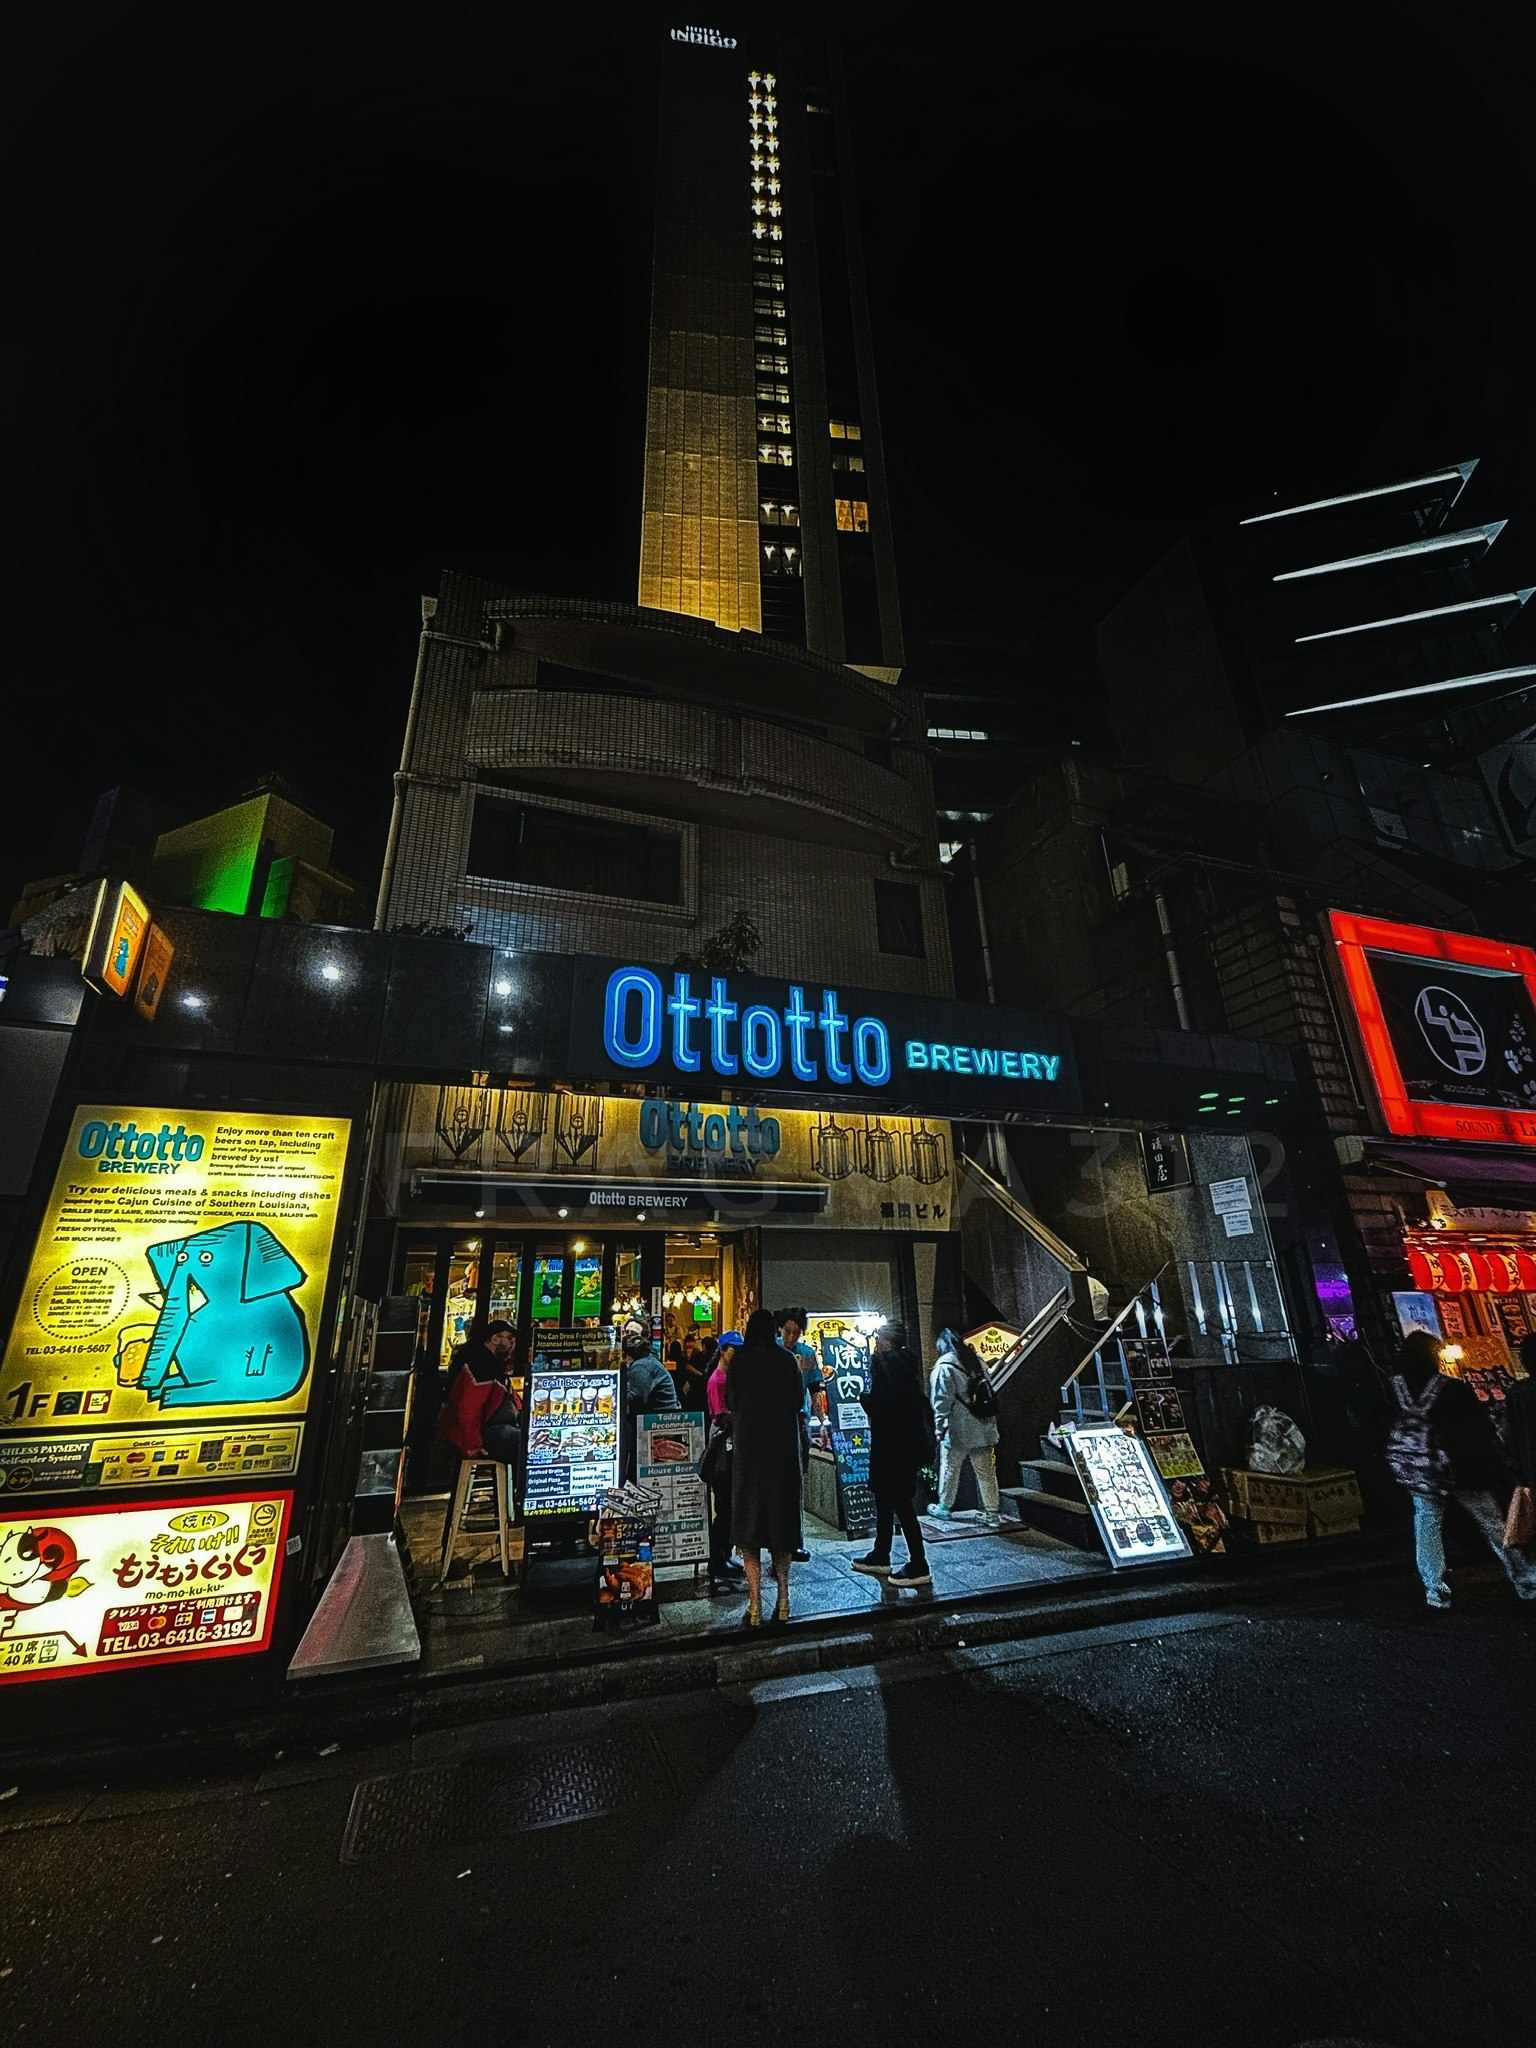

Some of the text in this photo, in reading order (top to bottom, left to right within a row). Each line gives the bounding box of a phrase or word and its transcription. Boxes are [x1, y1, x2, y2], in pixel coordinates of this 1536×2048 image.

[670, 28, 737, 49] INDIGO
[604, 966, 1060, 1087] Ottotto BREWERY
[640, 1098, 781, 1155] Ottotto
[1456, 1120, 1494, 1134] SOUND
[216, 1127, 243, 1137] Enjoy
[272, 1129, 293, 1137] than
[312, 1132, 335, 1140] craft
[78, 1121, 205, 1162] Ottotto
[215, 1136, 242, 1145] beers
[259, 1140, 277, 1148] tap,
[279, 1141, 321, 1150] including
[211, 1153, 248, 1162] brewed
[98, 1161, 181, 1174] BREWERY
[667, 1154, 759, 1175] BREWERY
[68, 1185, 89, 1196] Try
[89, 1187, 110, 1195] our
[111, 1186, 162, 1196] delicious
[164, 1188, 197, 1197] meals
[211, 1189, 248, 1198] snacks
[251, 1190, 297, 1201] including
[299, 1192, 331, 1200] dishes
[589, 1191, 688, 1207] Ottotto BREWERY
[117, 1197, 149, 1208] Cajun
[152, 1197, 192, 1207] Cuisine
[195, 1199, 207, 1207] of
[209, 1199, 256, 1208] Southern
[259, 1200, 311, 1210] Louisiana,
[880, 1201, 946, 1220] 福田ビル
[72, 1267, 108, 1276] OPEN
[537, 1333, 547, 1341] You
[576, 1332, 597, 1341] Freshly
[536, 1340, 563, 1348] Japanese
[829, 1344, 865, 1400] 焼肉
[542, 1378, 565, 1389] Craft
[6, 1381, 51, 1418] 1F
[658, 1413, 689, 1421] Today's
[651, 1420, 696, 1429] Recommend
[40, 1443, 91, 1455] PAYMENT
[0, 1454, 82, 1465] Self-order System
[647, 1465, 694, 1475] House Beer
[182, 1514, 217, 1529] 焼肉
[680, 1522, 700, 1530] Beer
[119, 1621, 139, 1632] VISA
[103, 1620, 252, 1654] TEL.03-6416-3192
